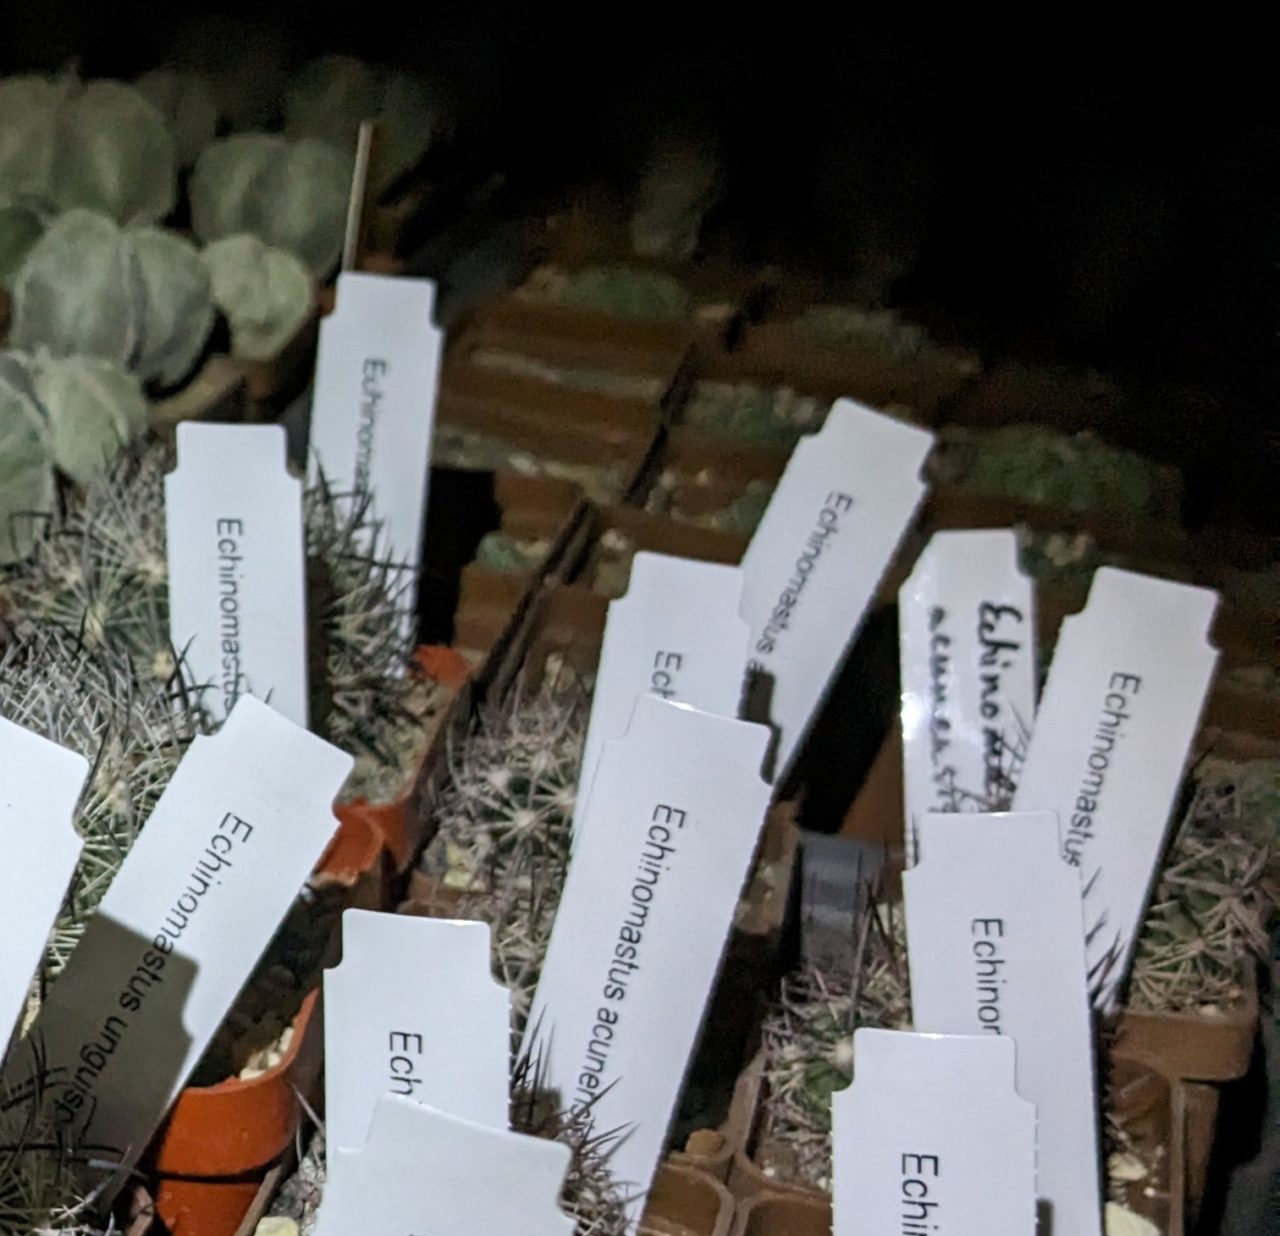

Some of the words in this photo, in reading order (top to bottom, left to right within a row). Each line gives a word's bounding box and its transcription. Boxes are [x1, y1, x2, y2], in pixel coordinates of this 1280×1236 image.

[756, 491, 854, 655] Echinomastus
[119, 811, 254, 1013] Echinomastus
[604, 803, 687, 1002] Echinomastus
[389, 1031, 423, 1100] Ech
